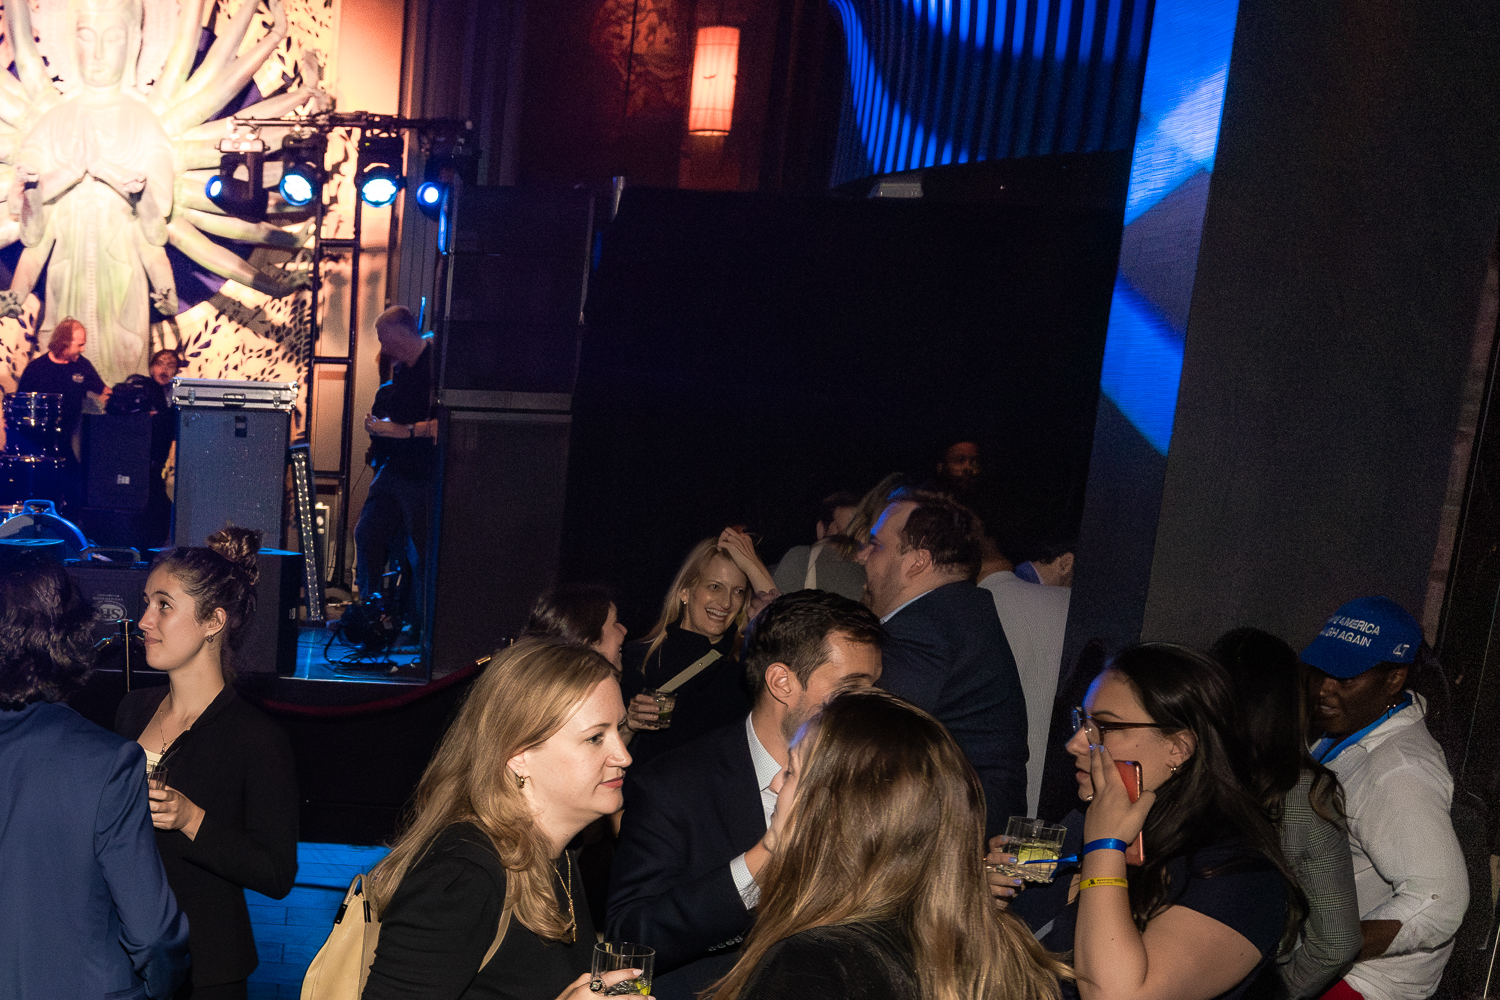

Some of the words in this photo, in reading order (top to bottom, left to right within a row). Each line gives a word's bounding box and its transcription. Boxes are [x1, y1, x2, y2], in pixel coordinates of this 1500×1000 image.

[1339, 617, 1380, 635] AMERICA
[1337, 631, 1371, 647] AGAIN
[1393, 644, 1409, 657] 47
